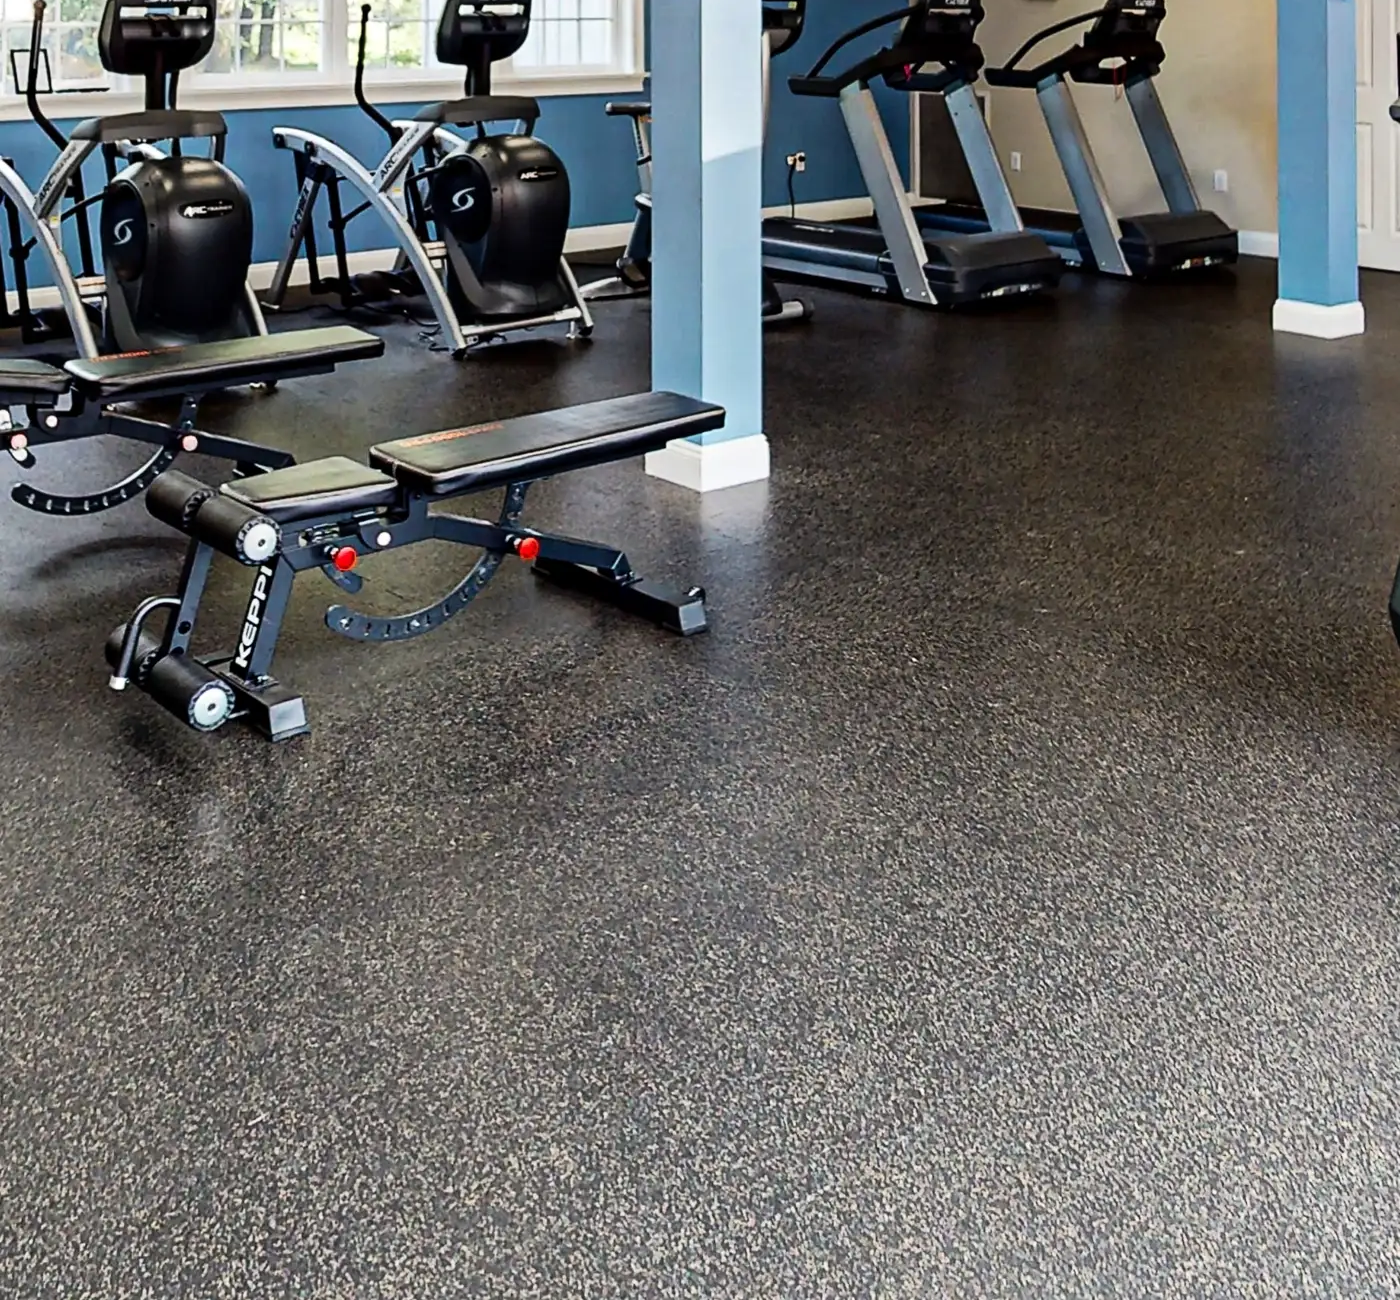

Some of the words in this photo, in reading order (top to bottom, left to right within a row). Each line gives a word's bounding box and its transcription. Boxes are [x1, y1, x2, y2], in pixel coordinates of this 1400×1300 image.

[380, 152, 399, 180] ARC
[520, 171, 538, 180] ARC
[39, 172, 57, 201] ARC
[183, 205, 207, 217] ARC
[235, 565, 273, 668] KEPPI
